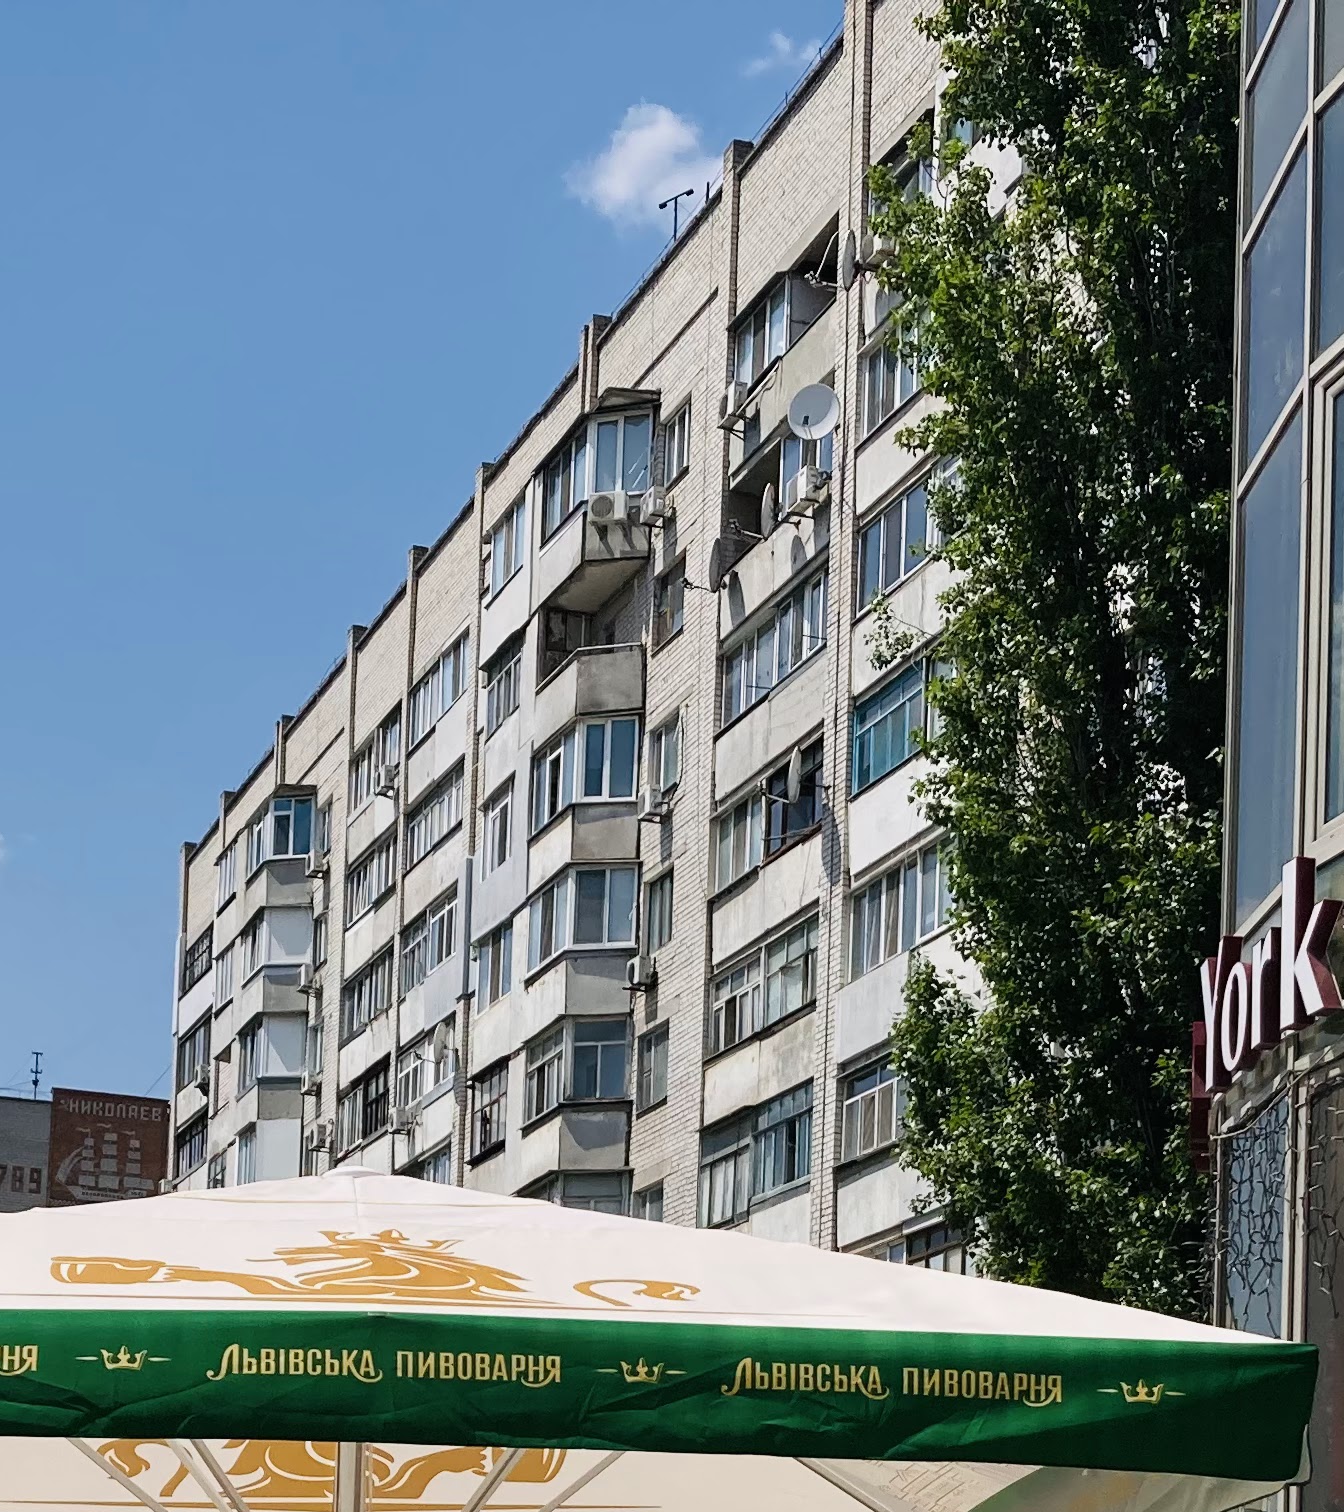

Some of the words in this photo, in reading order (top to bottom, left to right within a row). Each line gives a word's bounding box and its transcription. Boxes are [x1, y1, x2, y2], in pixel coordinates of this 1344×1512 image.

[1201, 857, 1344, 1093] York
[69, 1099, 162, 1121] НИКОЛАЕВ
[396, 1350, 561, 1388] ПИВОВАРНЯ
[902, 1367, 1062, 1407] ПИВОВАРНЯ
